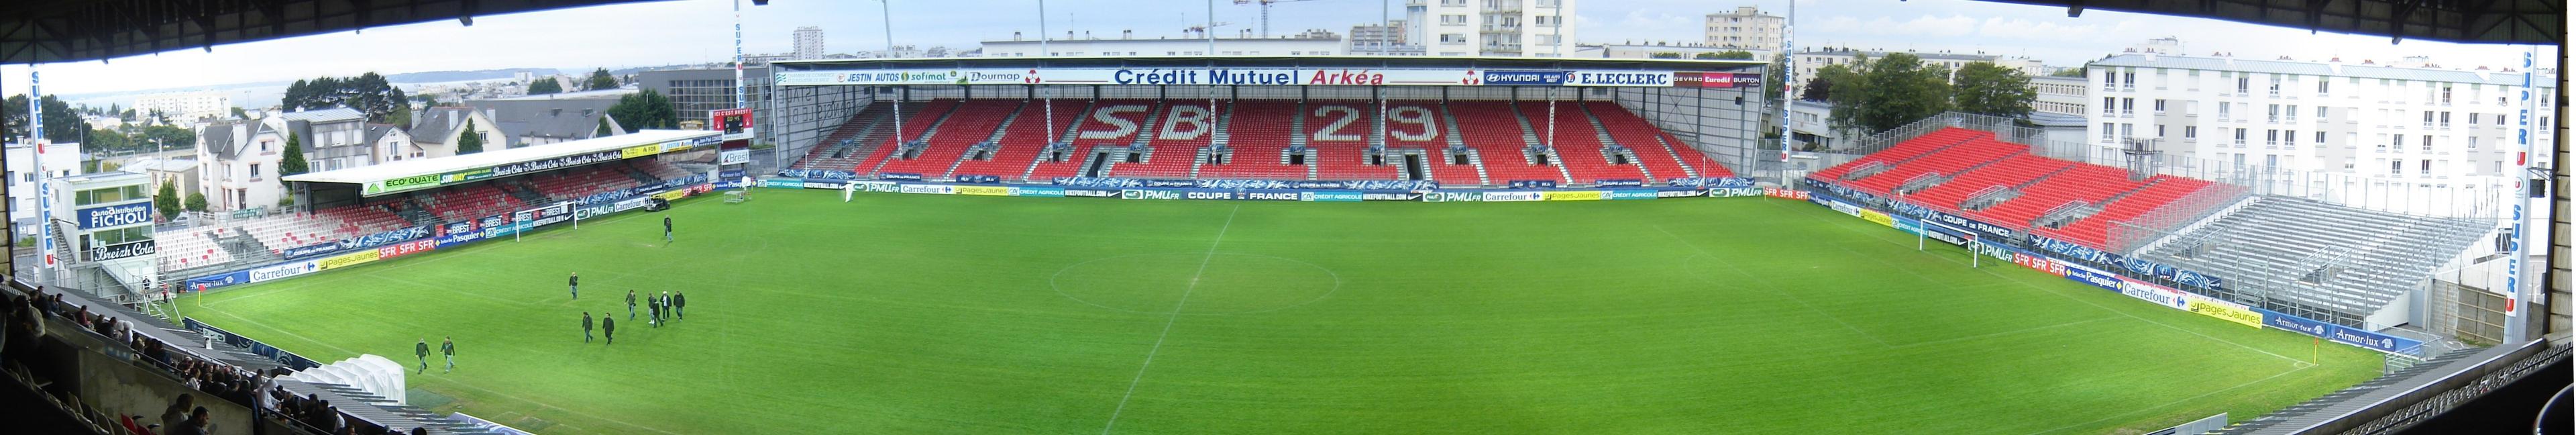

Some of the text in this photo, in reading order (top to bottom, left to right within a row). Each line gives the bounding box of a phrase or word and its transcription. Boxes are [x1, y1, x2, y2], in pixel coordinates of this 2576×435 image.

[848, 72, 900, 82] JESTIN AUTOS
[910, 71, 947, 81] sofimat
[1114, 69, 1385, 86] Crédit Mutuel Arkéa
[1501, 74, 1540, 82] HYUNDAI
[1581, 73, 1667, 85] E.LECLERC
[32, 71, 45, 154] SUPER U
[2516, 51, 2532, 166] SUPER U
[1079, 104, 1440, 141] SB 29
[730, 152, 748, 162] Brest
[440, 173, 464, 184] SUBWAY
[870, 183, 900, 193] PMU.FR
[903, 185, 940, 193] Carrefour
[1065, 189, 1107, 197] NIKEFOOTBALL.COM
[1144, 190, 1179, 199] PMU.FR
[1731, 188, 1762, 197] PMU.FR
[1764, 187, 1778, 195] SFR
[1780, 189, 1793, 197] SFR
[1796, 191, 1809, 199] SFR
[1187, 191, 1231, 199] COUPE
[1249, 192, 1298, 200] FRANCE
[1446, 192, 1481, 202] PMU.FR
[1485, 193, 1527, 201] Carrefour
[590, 204, 614, 216] PMU.FR
[615, 199, 642, 212] Carrefour
[1832, 201, 1853, 214] Carrefour
[42, 182, 54, 265] SUPER U
[91, 210, 147, 228] FICHOU
[485, 218, 502, 228] BREST
[1943, 214, 1968, 226] COUPE
[1978, 223, 2010, 237] FRANCE
[452, 224, 470, 234] BREST
[452, 232, 480, 243] Pasquier
[95, 242, 154, 261] Breizh Cola
[380, 239, 435, 258] SFR SFR SFR
[1985, 246, 2013, 262] PMU.FR
[2507, 203, 2521, 293] SUPER
[328, 252, 378, 267] PagesJaunes
[2015, 252, 2029, 267] SFR
[2032, 257, 2047, 271] SFR
[2050, 262, 2065, 276] SFR
[253, 266, 301, 281] Carrefour
[2086, 271, 2116, 289] Pasquier
[2124, 283, 2171, 305] Carrefour
[2506, 297, 2514, 312] U
[2200, 303, 2261, 326] PagesJaunes
